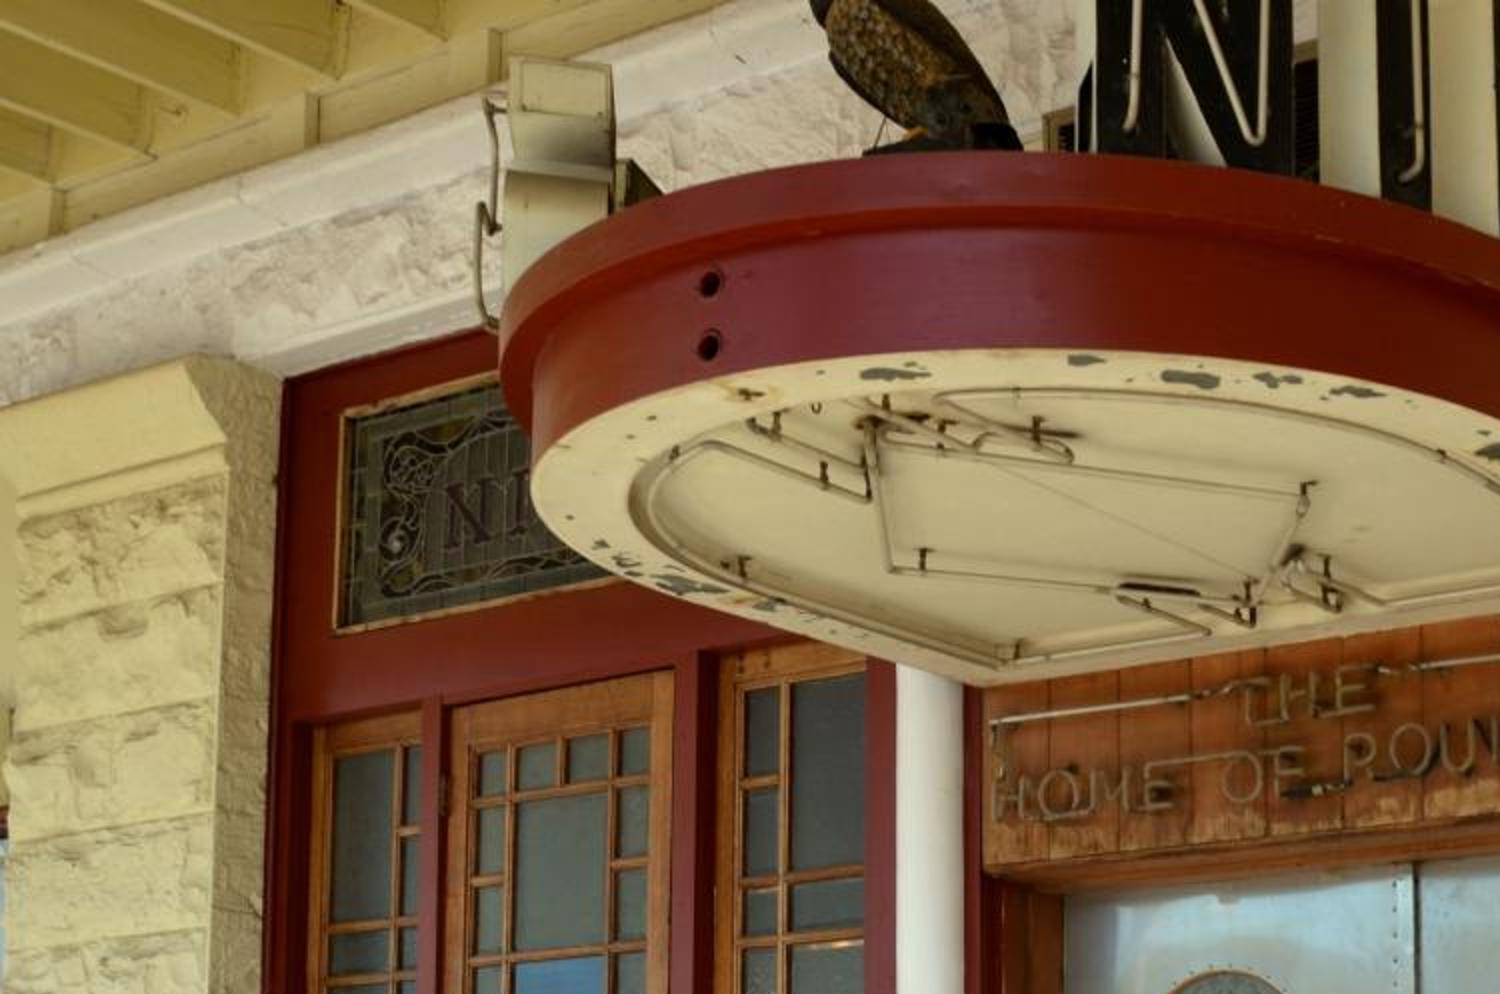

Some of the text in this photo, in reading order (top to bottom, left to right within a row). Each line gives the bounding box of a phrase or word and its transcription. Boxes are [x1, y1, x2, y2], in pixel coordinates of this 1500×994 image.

[1233, 664, 1378, 726] THE
[991, 760, 1176, 822] HOME
[1221, 745, 1306, 802] OF
